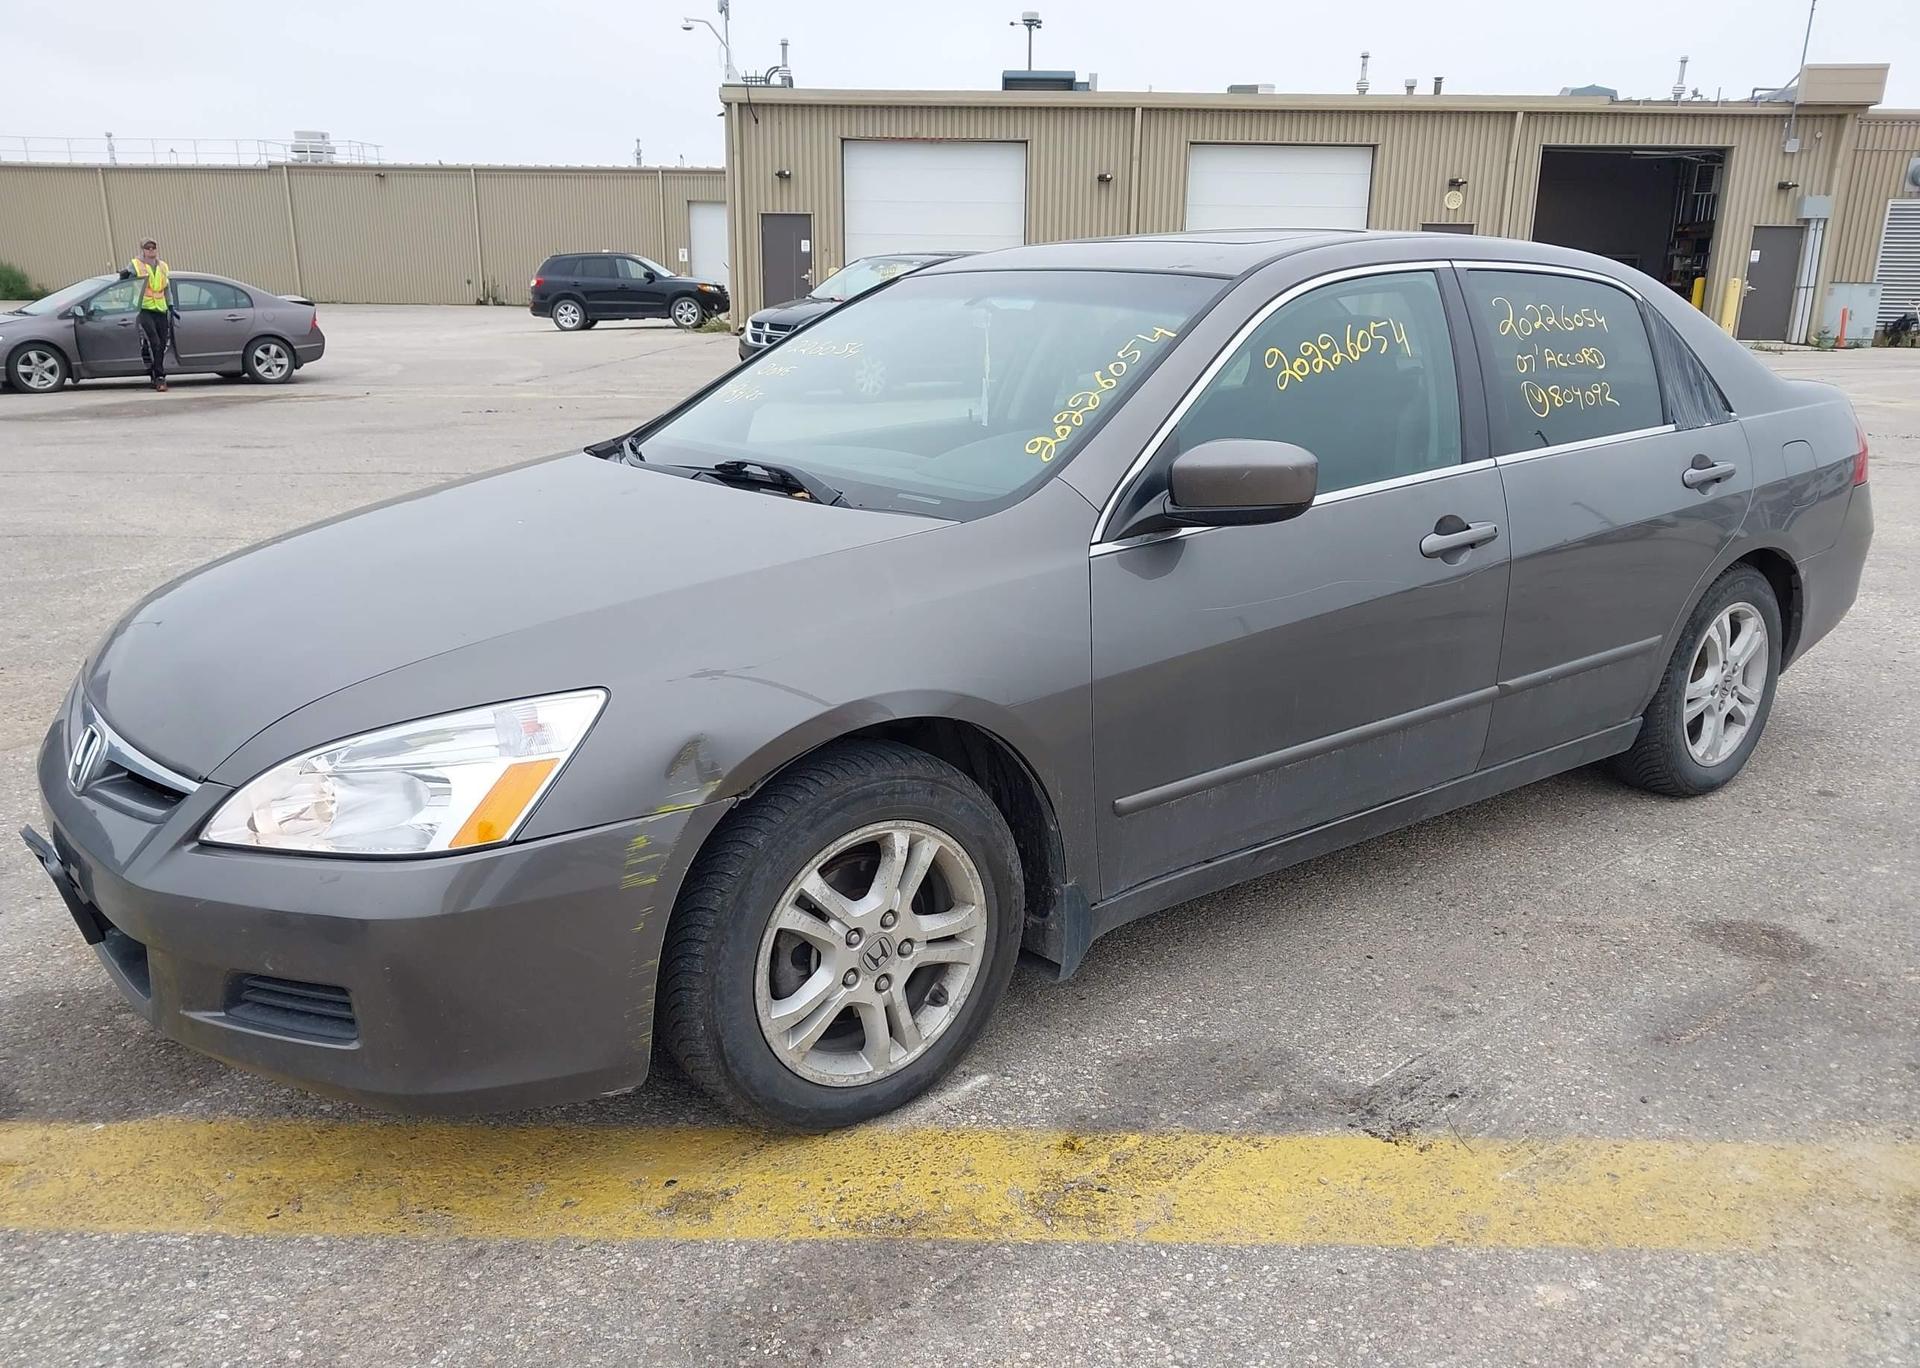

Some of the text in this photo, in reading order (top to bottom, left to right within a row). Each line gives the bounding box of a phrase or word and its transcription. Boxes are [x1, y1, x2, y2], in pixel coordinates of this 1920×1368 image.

[1491, 296, 1608, 340] 20226054
[1264, 318, 1412, 390] 20226054
[1544, 347, 1606, 369] ACCORD
[1025, 326, 1177, 462] 20226054
